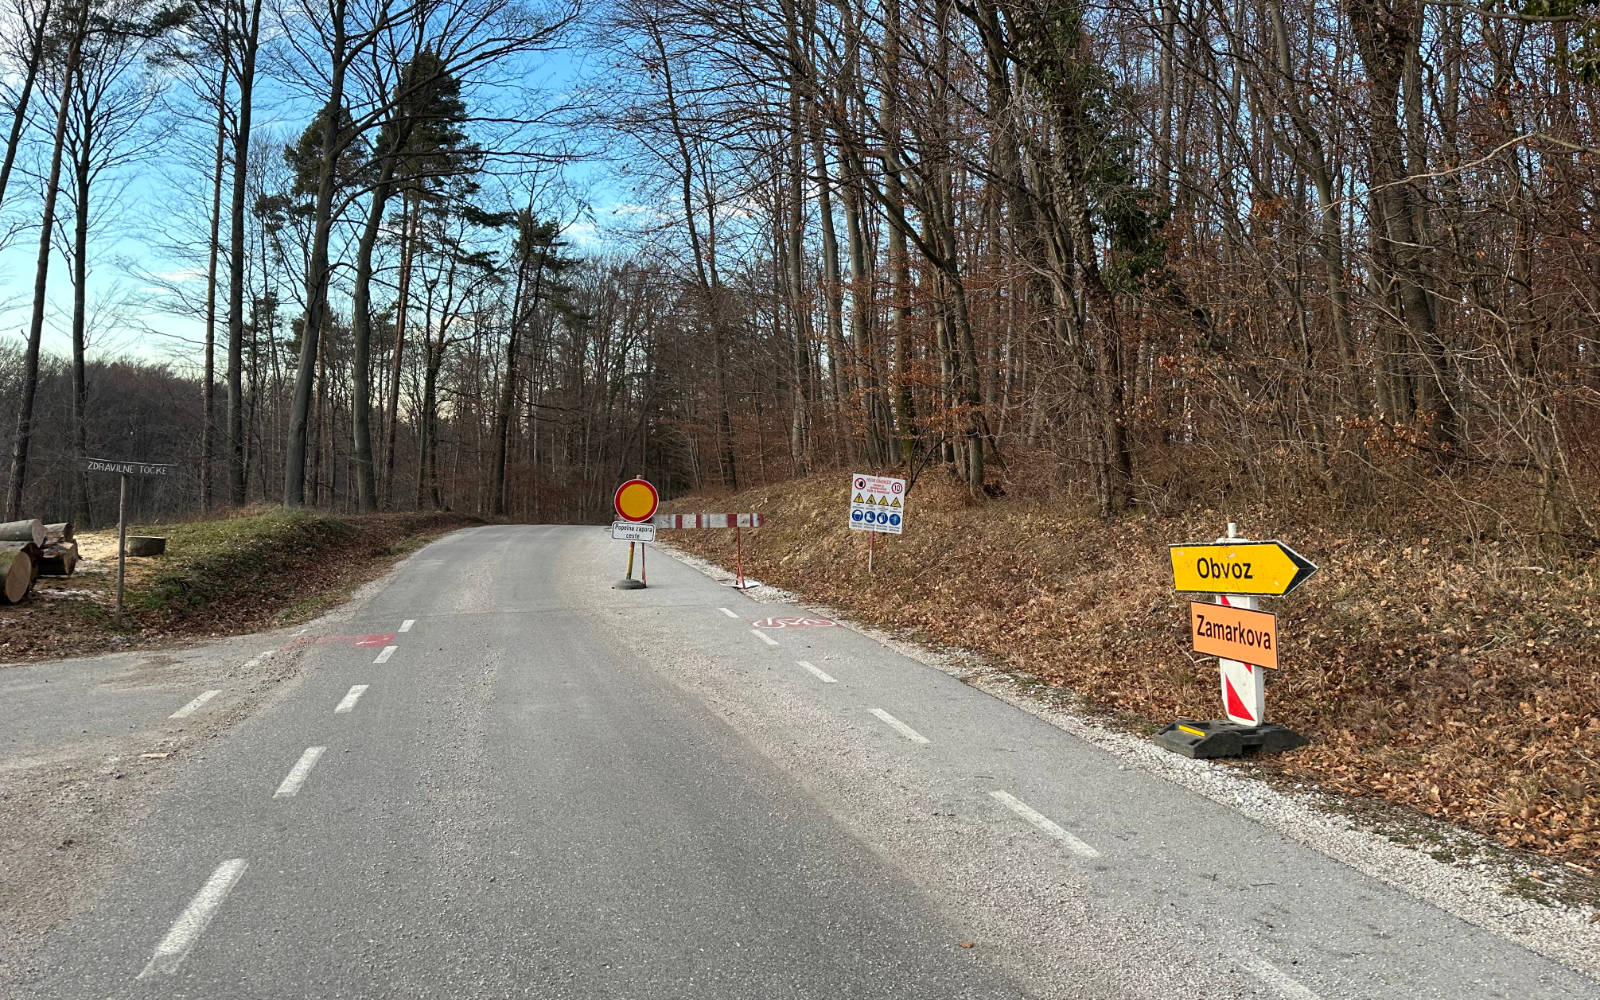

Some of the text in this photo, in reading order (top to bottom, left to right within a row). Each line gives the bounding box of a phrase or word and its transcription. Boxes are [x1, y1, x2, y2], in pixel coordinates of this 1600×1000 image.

[88, 461, 134, 474] ZDRAVILNE
[894, 484, 901, 492] 10
[614, 523, 634, 532] Popolna
[1197, 557, 1253, 579] Obvoz
[1197, 614, 1271, 650] Zamarkova
